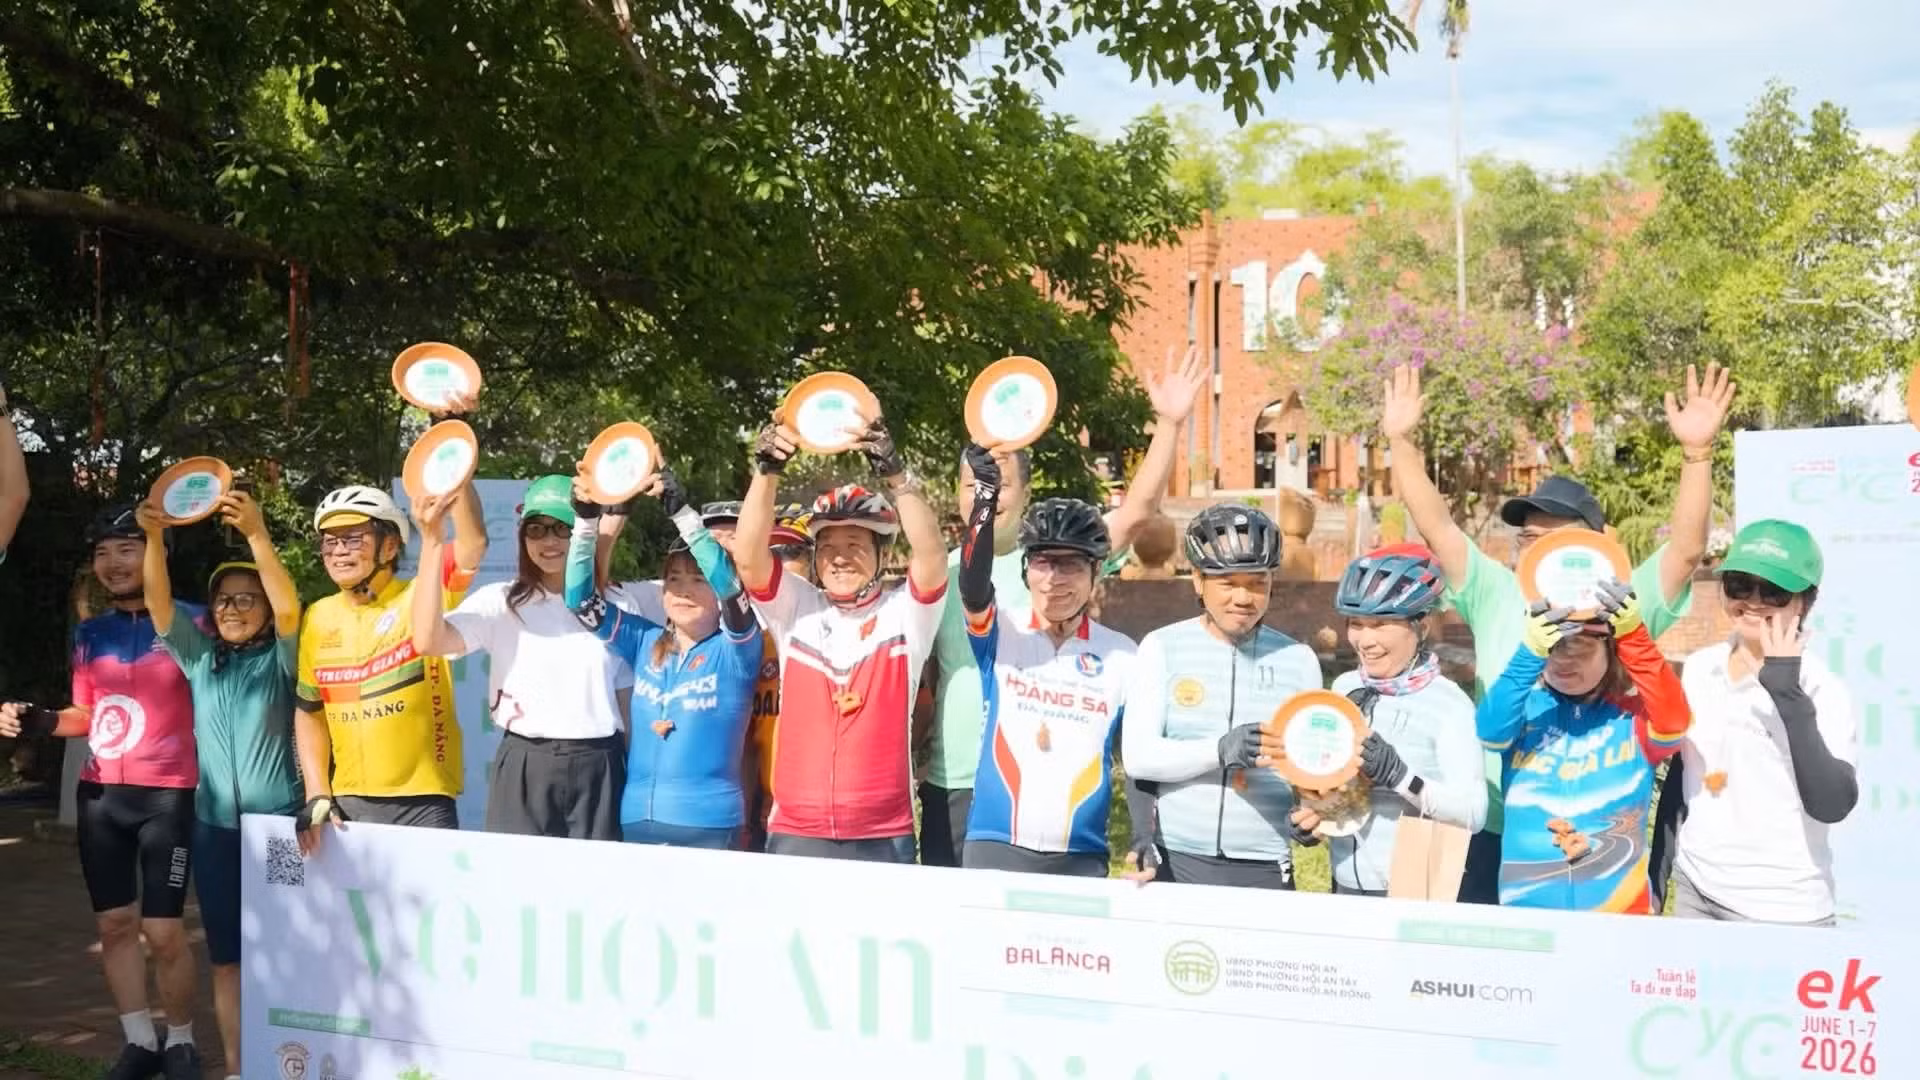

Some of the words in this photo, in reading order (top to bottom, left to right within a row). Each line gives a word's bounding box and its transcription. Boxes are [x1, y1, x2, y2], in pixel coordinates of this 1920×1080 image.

[1082, 697, 1108, 716] SA
[1006, 947, 1110, 974] BALANCA
[1323, 965, 1337, 974] AN
[1323, 976, 1337, 986] AN
[1801, 1015, 1841, 1036] JUNE
[1800, 1036, 1877, 1076] 2026
